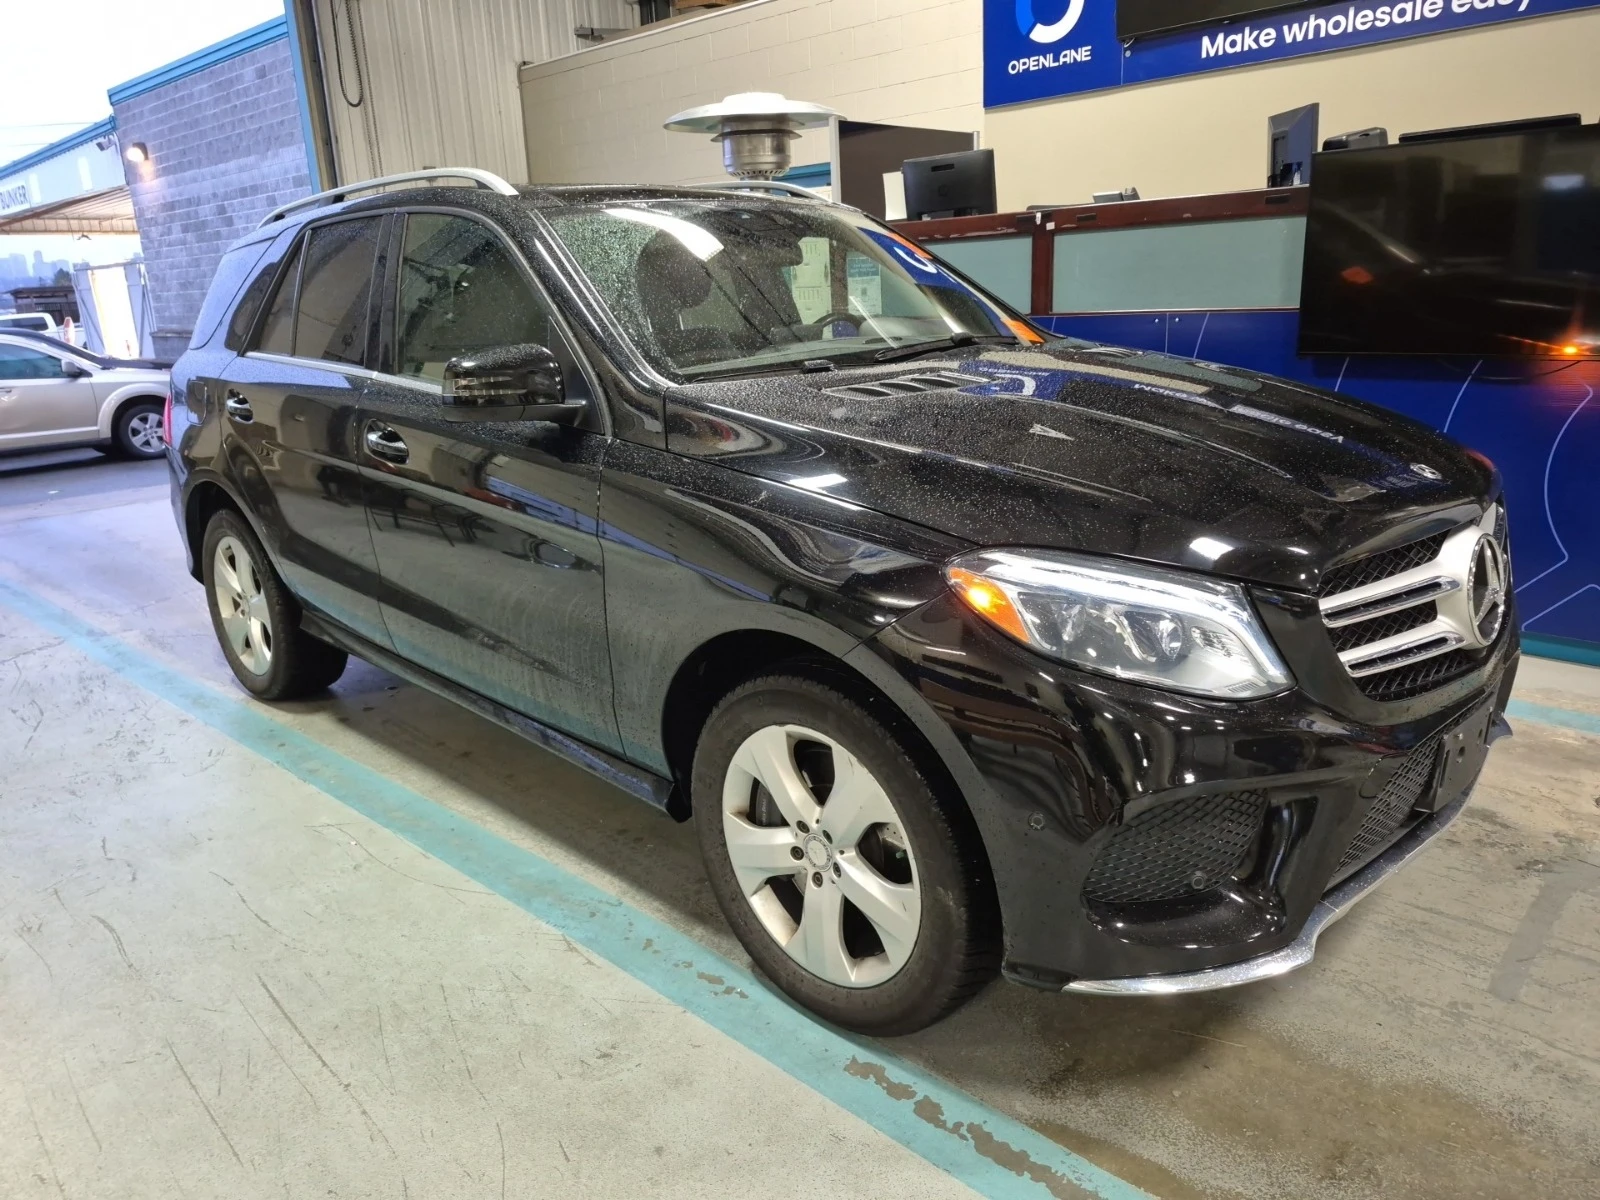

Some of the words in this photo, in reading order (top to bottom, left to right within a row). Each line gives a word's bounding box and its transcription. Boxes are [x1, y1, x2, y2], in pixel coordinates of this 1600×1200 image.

[1200, 26, 1277, 59] Make
[1282, 0, 1444, 44] wholesale
[1451, 0, 1530, 13] ea
[1007, 45, 1092, 75] OPENLANE
